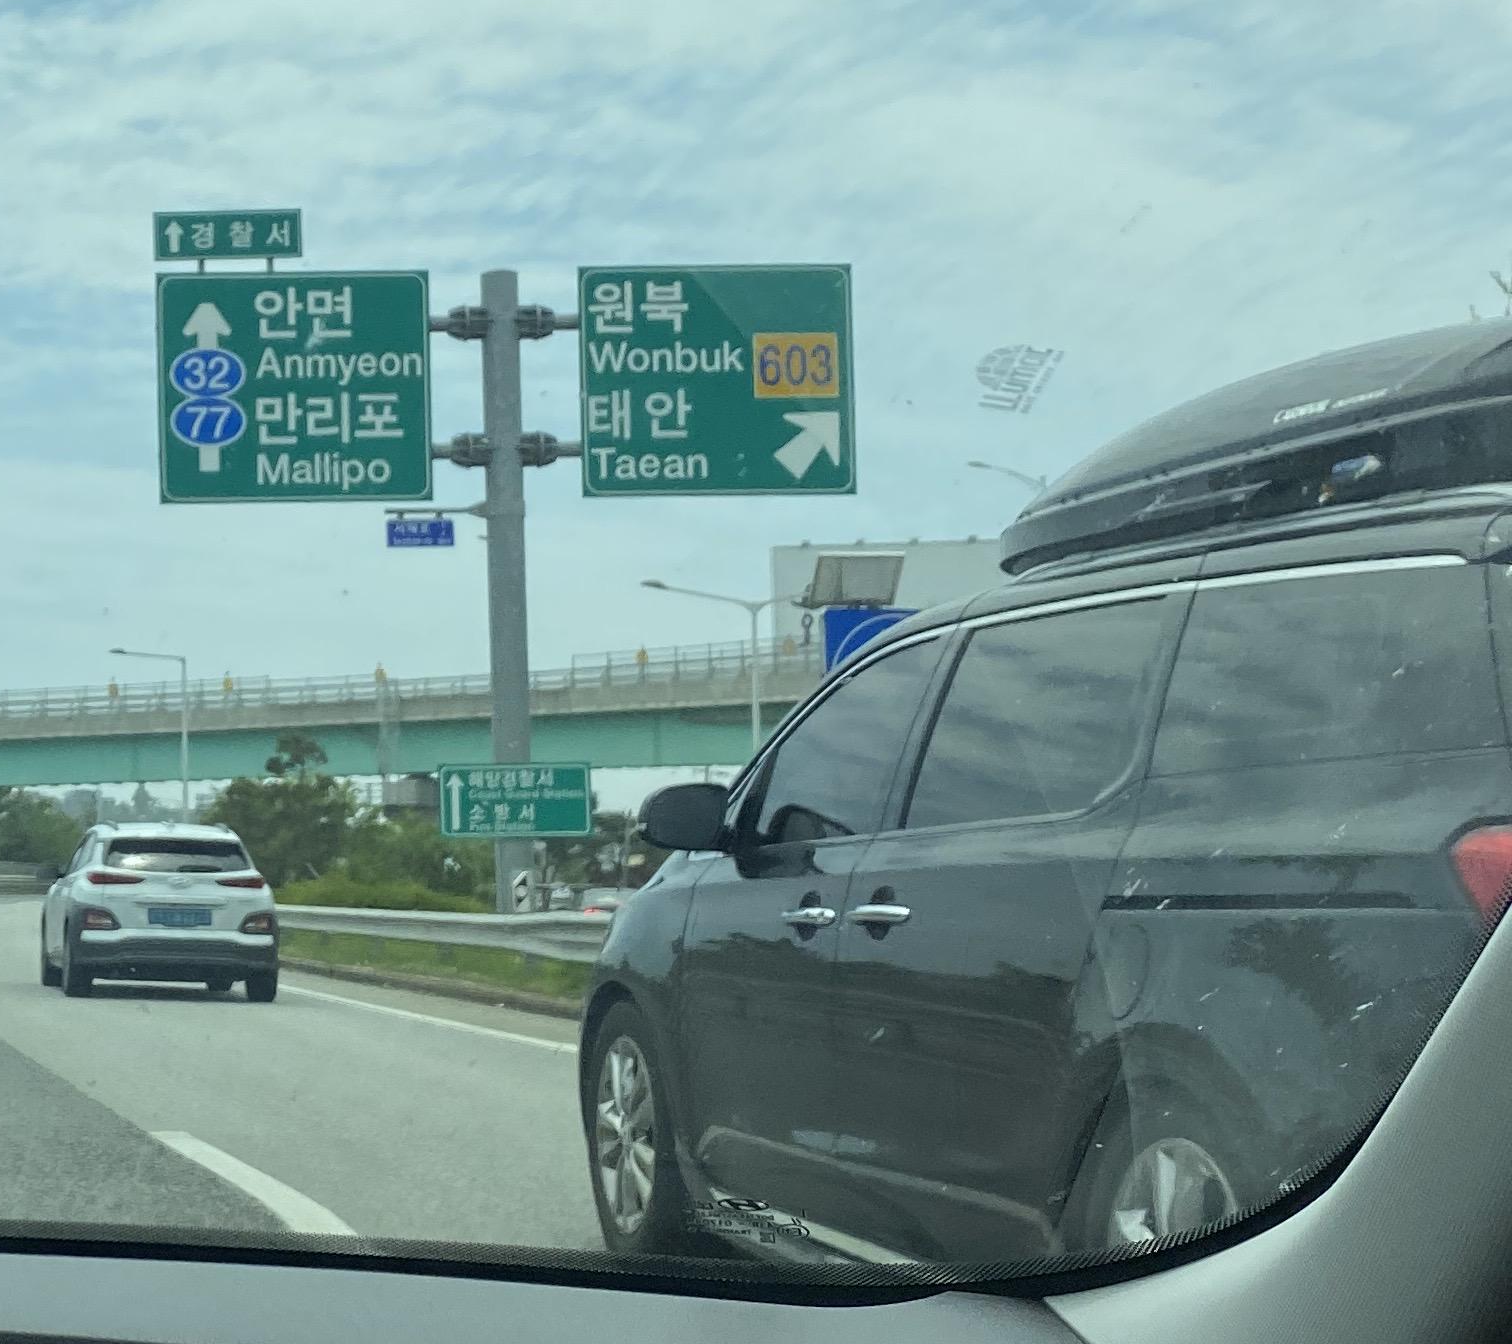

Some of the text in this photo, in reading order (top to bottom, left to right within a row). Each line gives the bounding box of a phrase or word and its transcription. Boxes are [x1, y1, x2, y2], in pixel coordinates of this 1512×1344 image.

[190, 220, 291, 249] 경찰서
[254, 285, 352, 338] 안면
[588, 280, 689, 334] 원북
[183, 356, 230, 390] 32
[255, 347, 423, 386] Anmyeon
[589, 340, 744, 373] Wonbuk
[759, 343, 833, 386] 603
[185, 407, 231, 439] 77
[255, 392, 404, 445] 만리포
[589, 388, 692, 440] 태안
[256, 453, 391, 491] Mallipo
[591, 446, 709, 479] Taean
